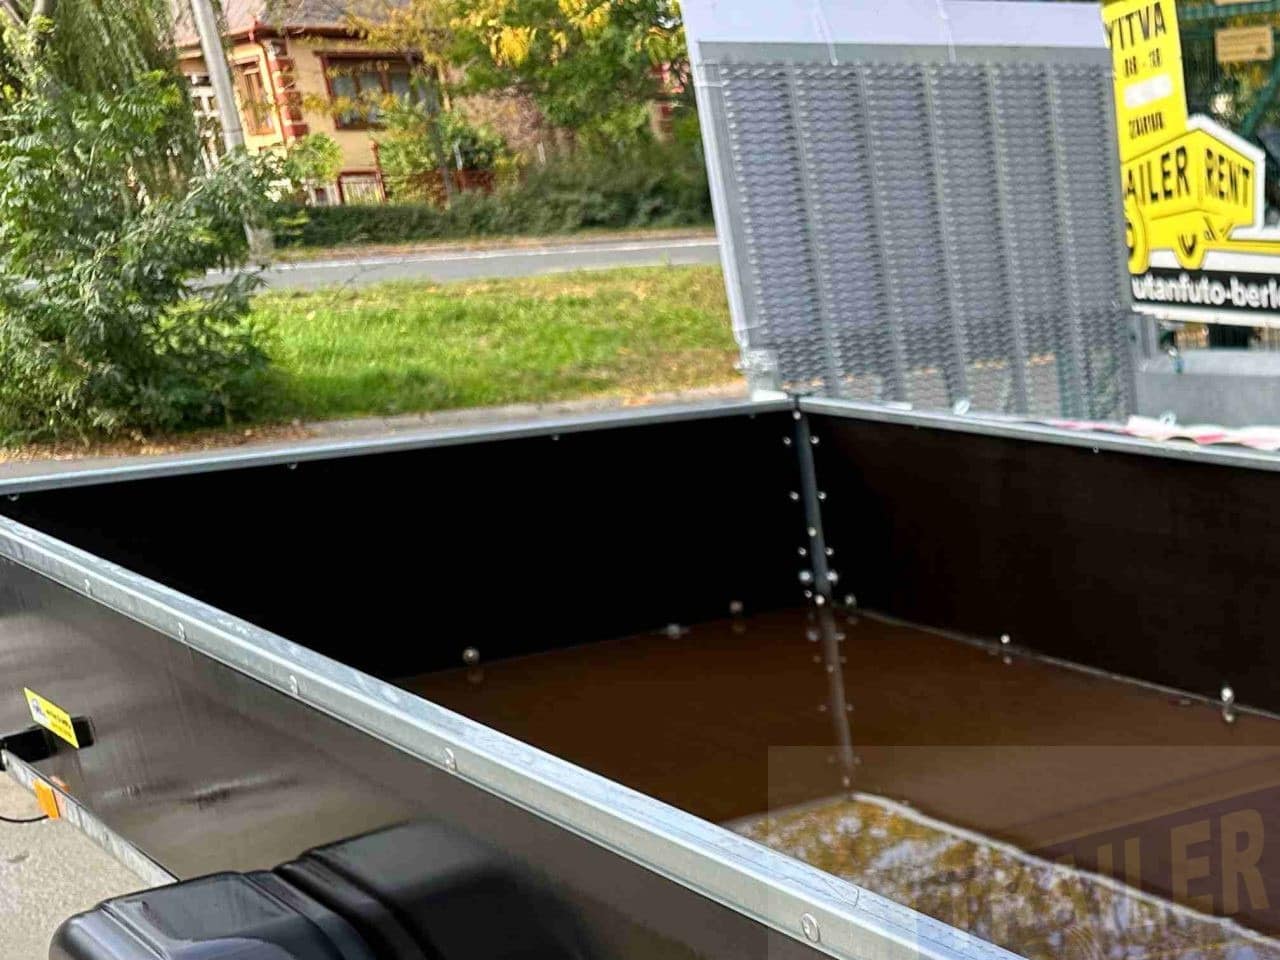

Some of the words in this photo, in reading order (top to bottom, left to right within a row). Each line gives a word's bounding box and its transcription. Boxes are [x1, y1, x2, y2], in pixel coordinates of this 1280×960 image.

[1105, 2, 1167, 50] YITVA
[1124, 146, 1191, 206] AILER
[1205, 147, 1250, 208] RENT
